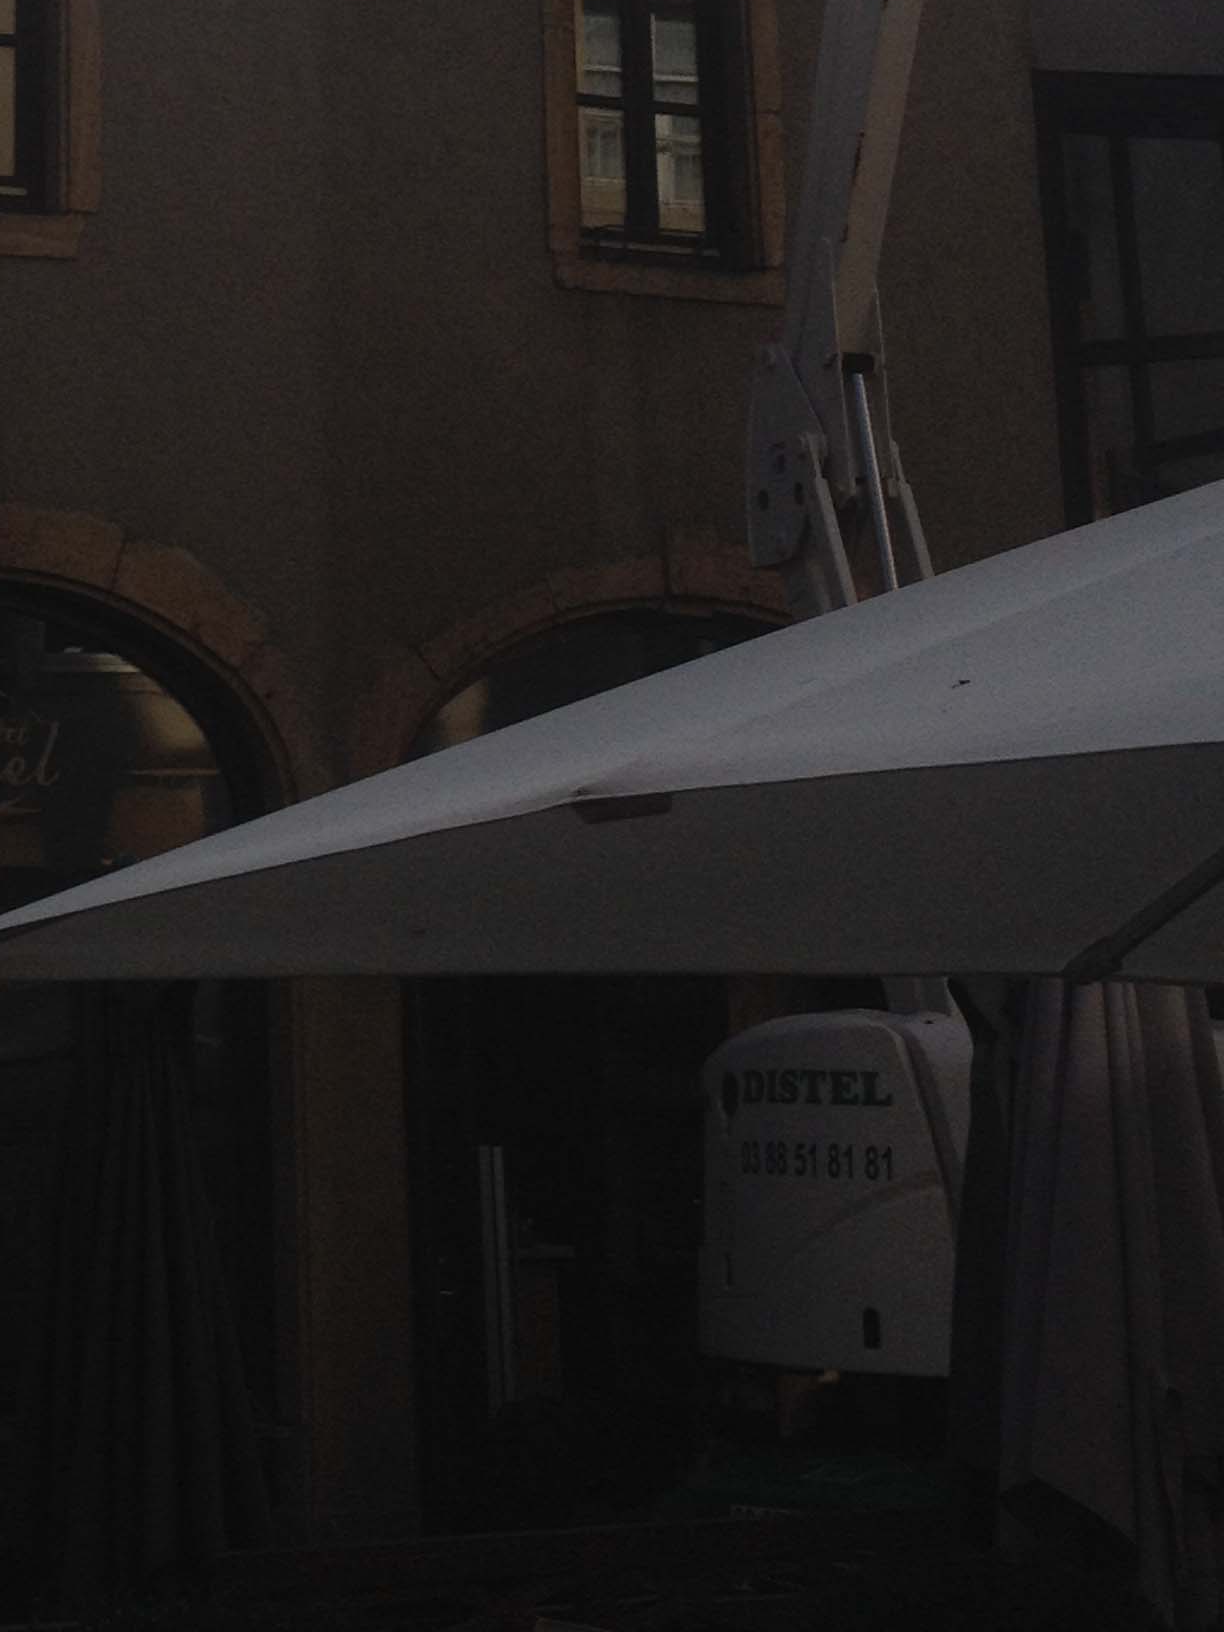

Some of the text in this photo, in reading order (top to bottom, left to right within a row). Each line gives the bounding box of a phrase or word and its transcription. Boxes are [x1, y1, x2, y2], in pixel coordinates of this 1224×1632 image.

[742, 1070, 893, 1106] DISTEL
[794, 1143, 818, 1178] 51
[828, 1143, 854, 1180] 81
[864, 1145, 893, 1182] 81
